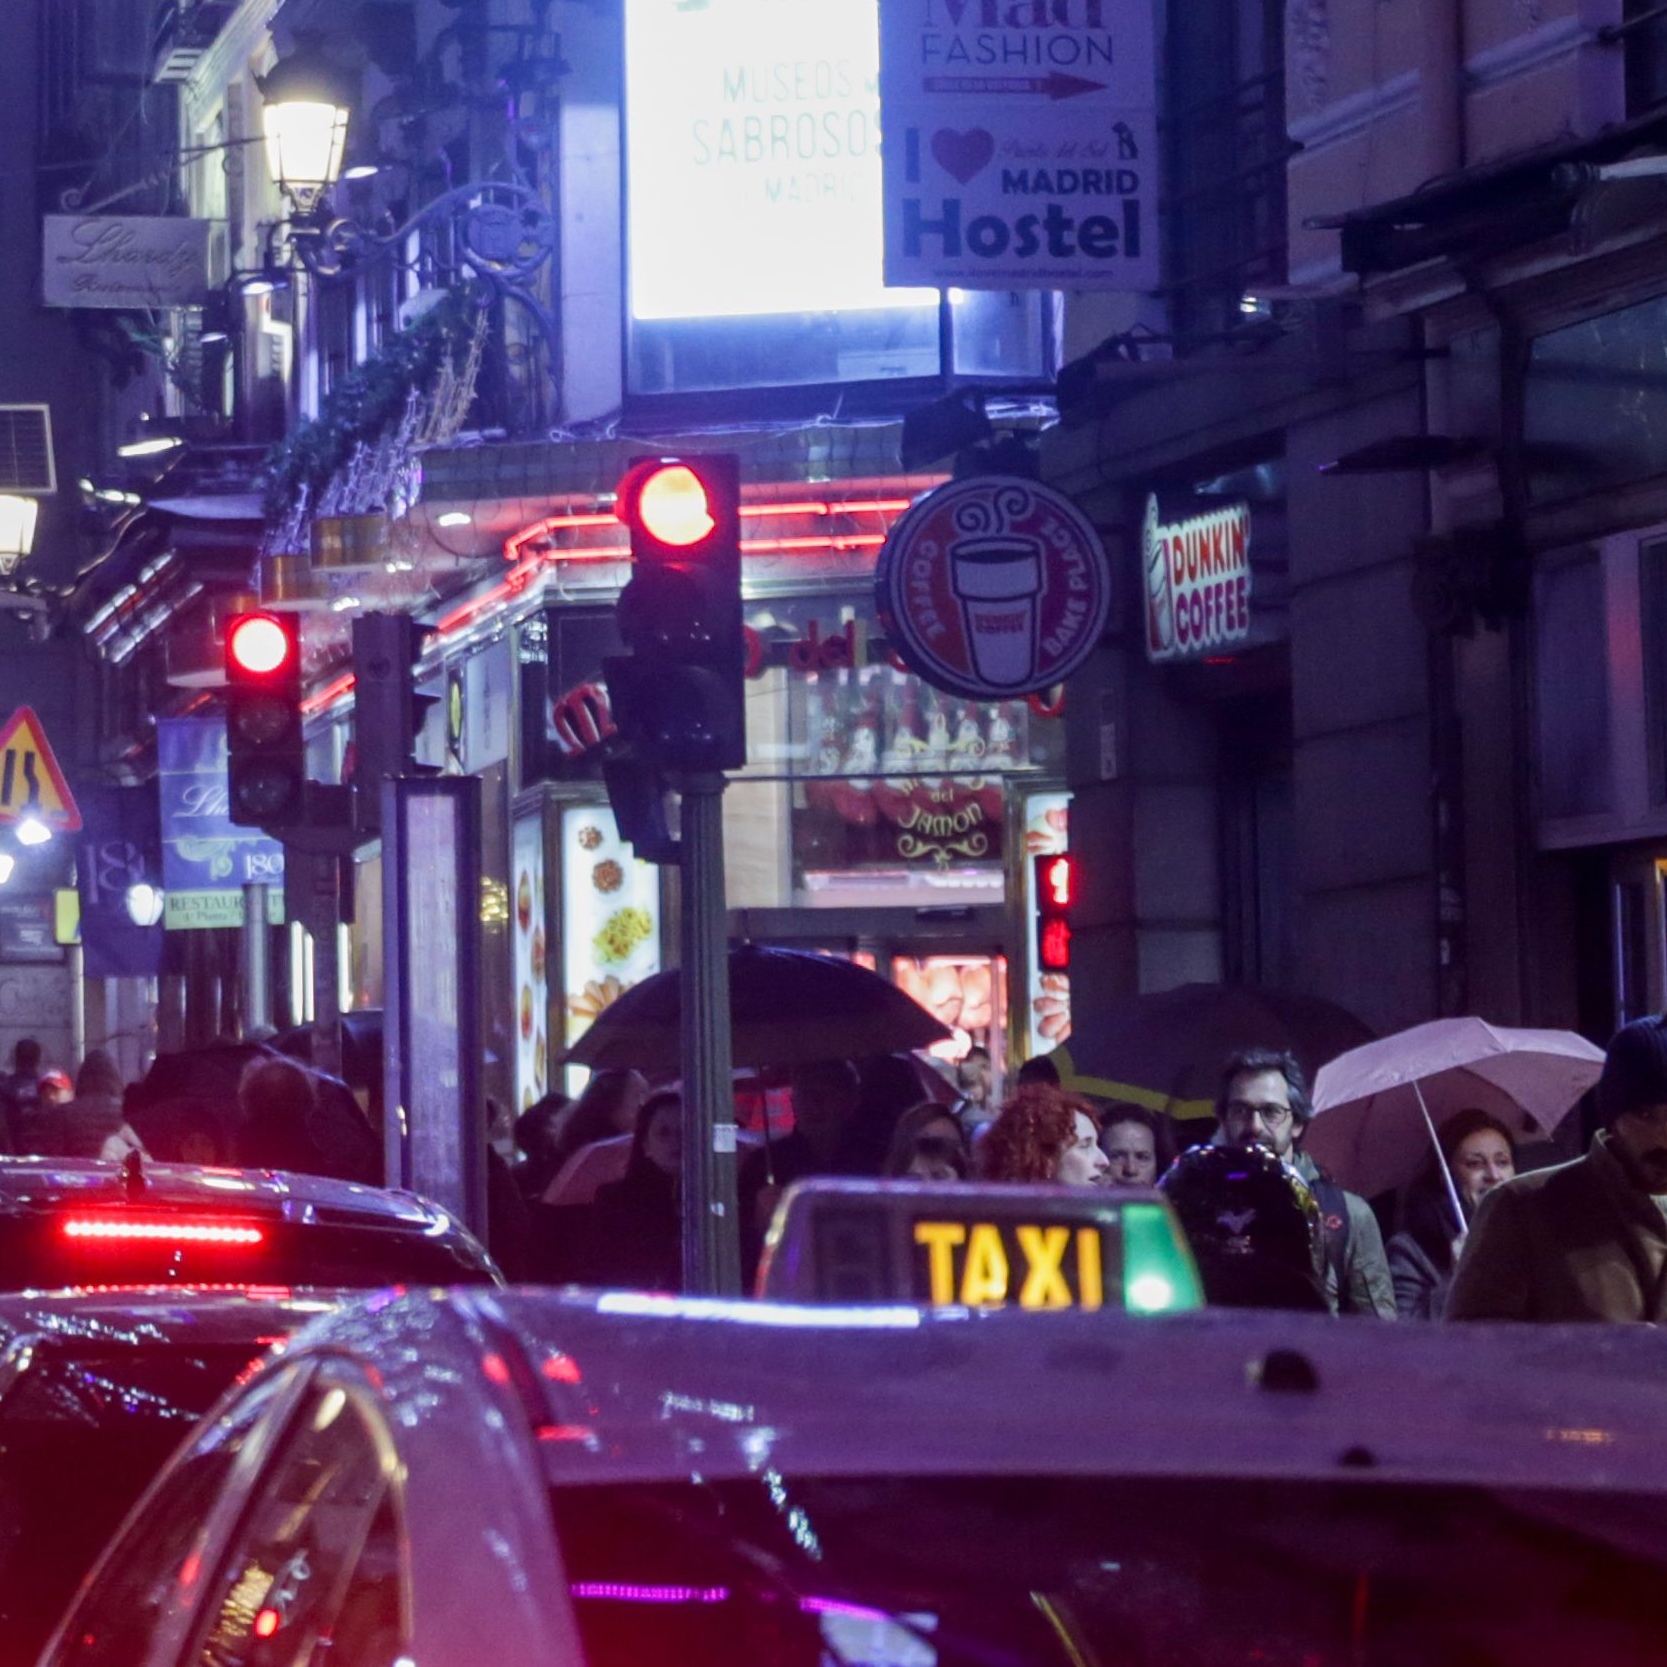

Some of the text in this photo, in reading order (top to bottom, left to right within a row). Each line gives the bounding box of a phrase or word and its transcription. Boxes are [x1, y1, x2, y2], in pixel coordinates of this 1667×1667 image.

[922, 34, 1114, 66] FASHION
[723, 58, 852, 103] MUSEOS
[905, 127, 919, 183] I
[1001, 168, 1141, 196] MADRID
[902, 198, 1141, 259] Hostel
[1172, 512, 1250, 587] DUNKIN'
[912, 539, 948, 639] COFFEE
[1175, 576, 1246, 645] COFFEE
[1042, 598, 1089, 658] BAKE
[898, 802, 983, 837] JAMON
[930, 788, 954, 803] del
[914, 1222, 1103, 1309] TAXI
